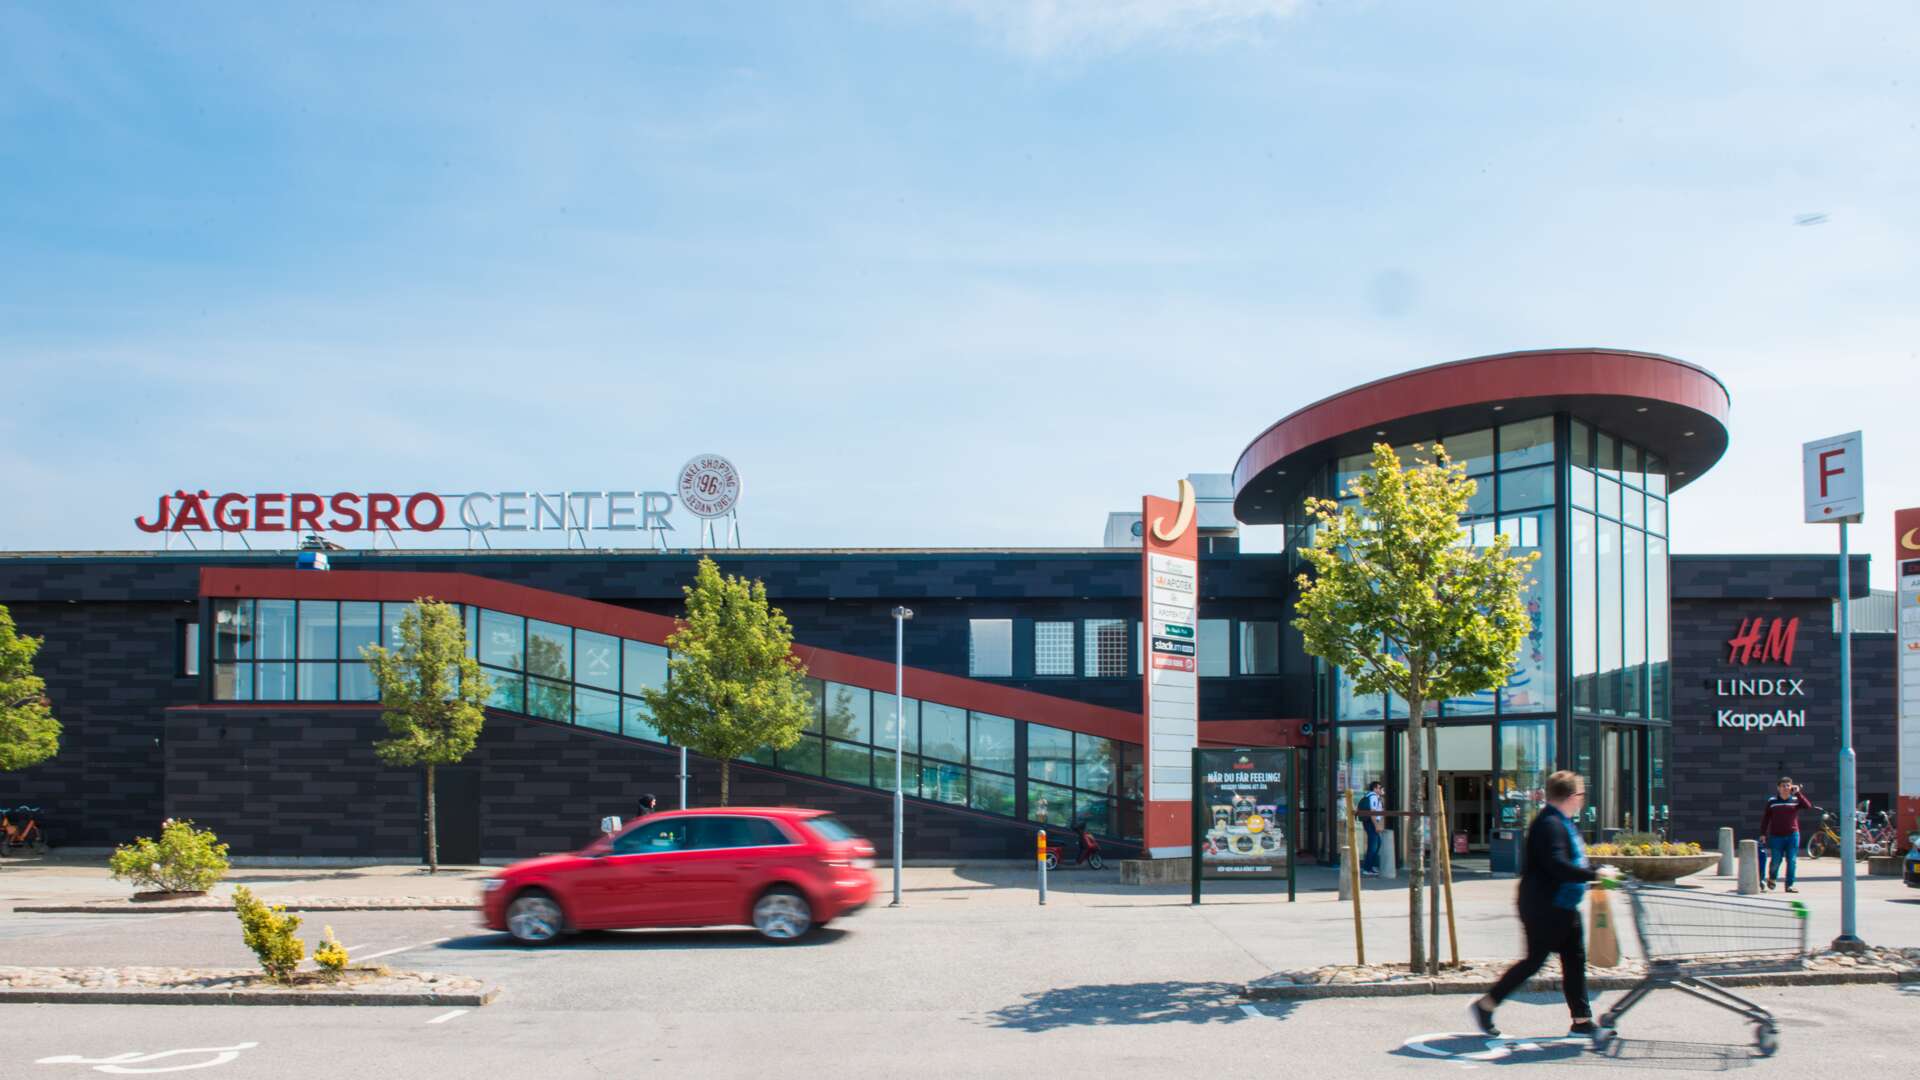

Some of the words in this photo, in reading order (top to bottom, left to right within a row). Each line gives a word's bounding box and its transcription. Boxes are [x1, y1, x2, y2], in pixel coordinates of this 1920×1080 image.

[682, 463, 700, 490] ENKEL
[700, 458, 736, 488] SHOPPING
[1819, 448, 1845, 497] F
[134, 489, 446, 533] JÄGERSRO
[459, 490, 676, 532] CENTER
[686, 494, 712, 513] SEDAN
[1166, 577, 1192, 590] APOTEK
[1728, 617, 1799, 666] H&M
[1717, 679, 1805, 697] LINDEX
[1717, 709, 1805, 731] KappAhl
[1208, 771, 1223, 782] NÄR
[1224, 772, 1234, 782] DU
[1235, 771, 1249, 782] FÅR
[1250, 772, 1280, 782] FEELING!
